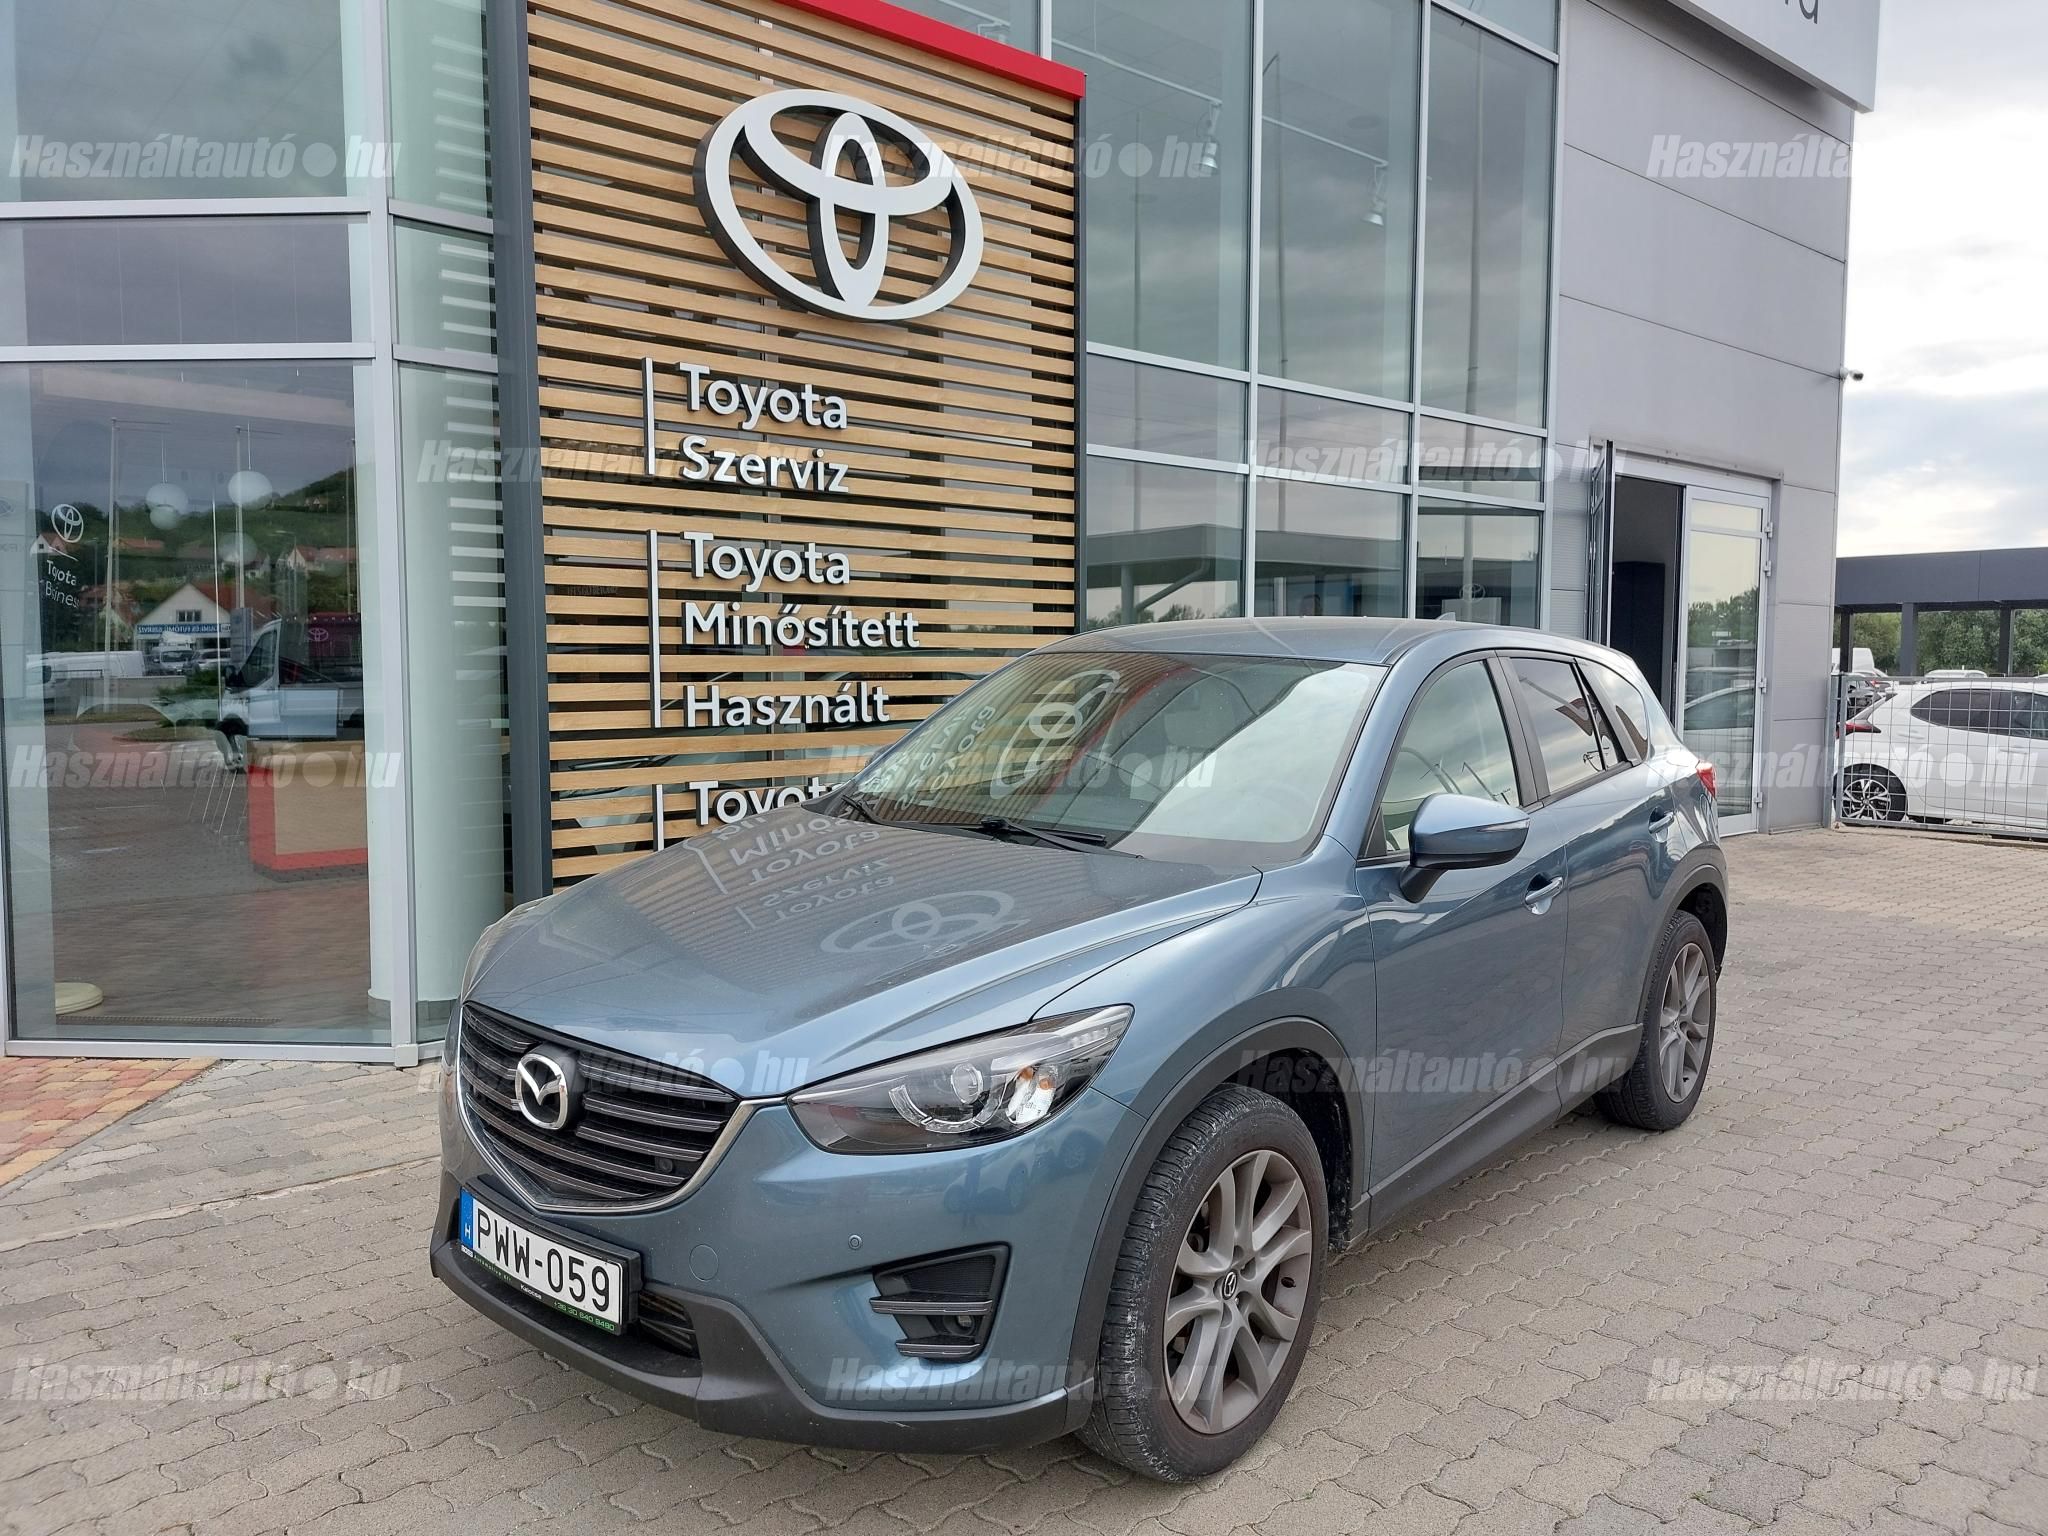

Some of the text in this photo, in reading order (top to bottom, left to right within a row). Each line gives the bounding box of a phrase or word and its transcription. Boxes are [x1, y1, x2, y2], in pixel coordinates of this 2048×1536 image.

[677, 362, 848, 431] Toyota
[681, 434, 850, 494] Szerviz
[682, 531, 851, 593] Toyota
[682, 599, 920, 649] Minősített
[684, 679, 891, 728] Használt
[689, 781, 838, 827] Toyot
[464, 1224, 471, 1240] H
[477, 1208, 609, 1312] PWW-059
